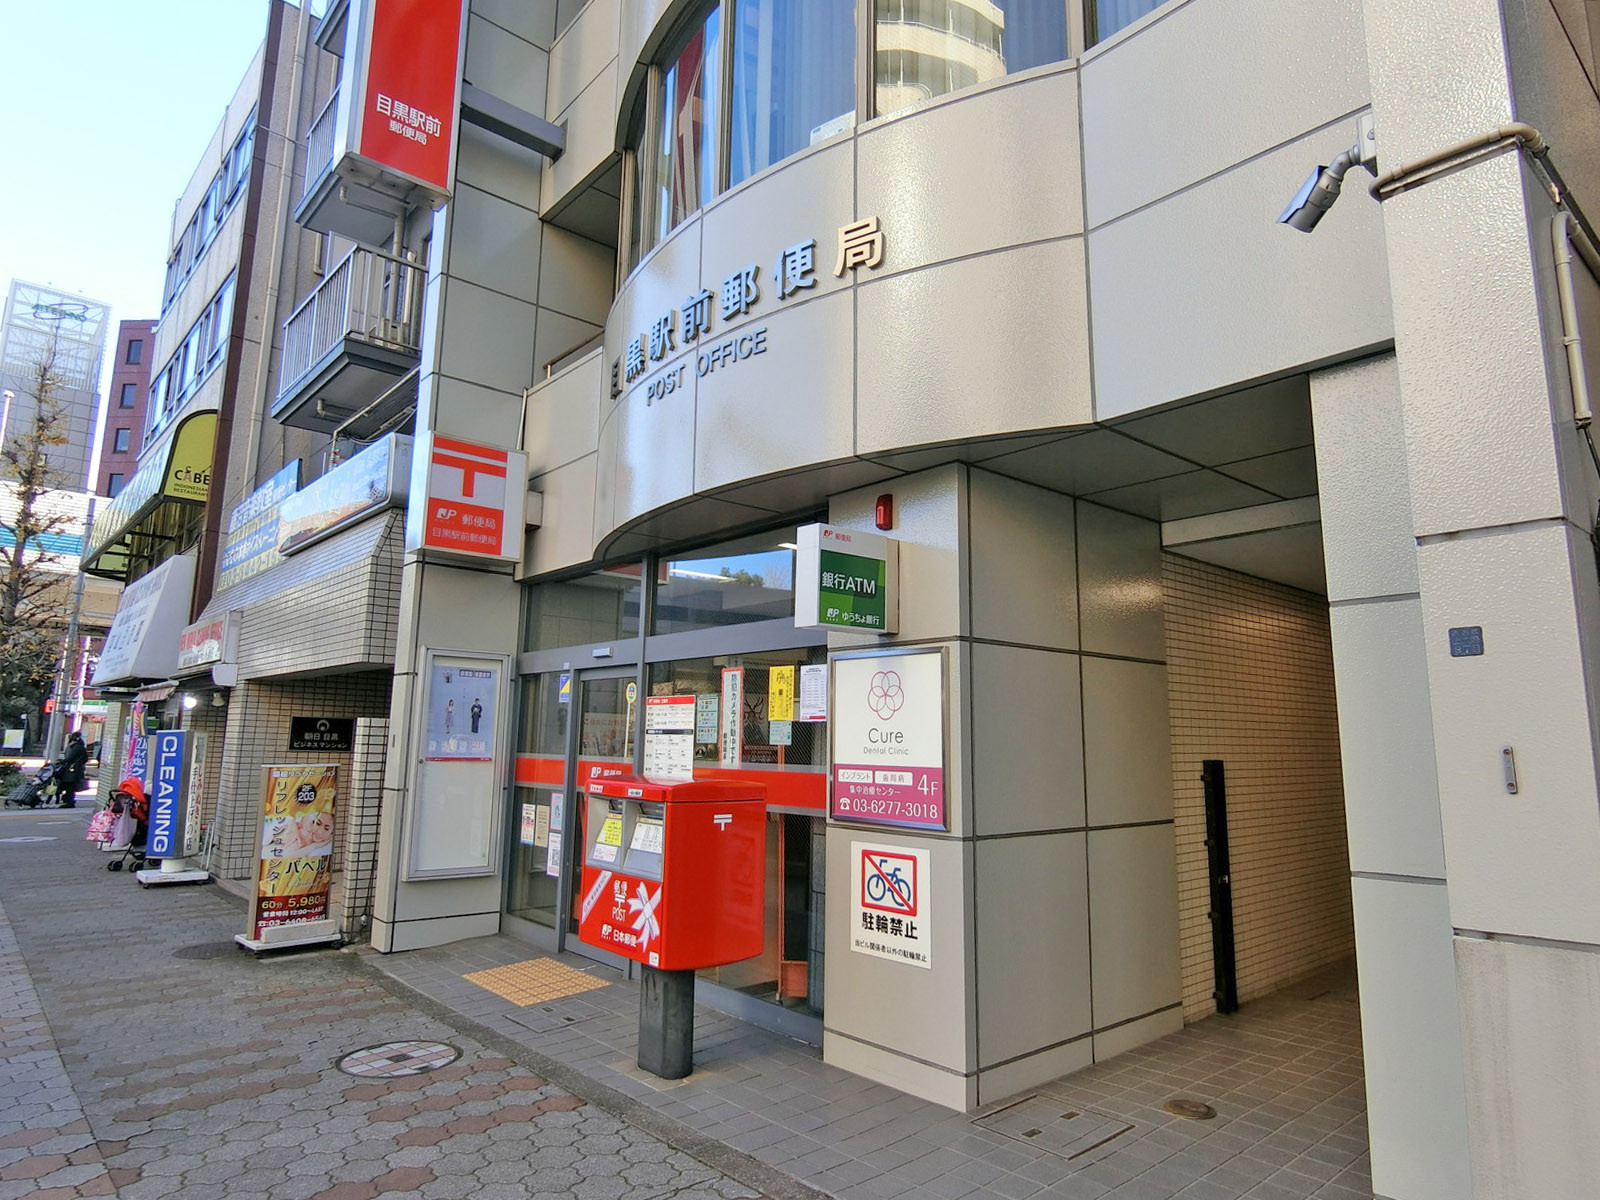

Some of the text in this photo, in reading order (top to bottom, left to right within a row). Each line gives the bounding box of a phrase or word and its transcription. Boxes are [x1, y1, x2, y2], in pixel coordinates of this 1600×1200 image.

[376, 93, 442, 137] 目黒駅前
[389, 119, 427, 145] 郵便局
[610, 215, 886, 401] 目黒駅前郵便局
[647, 327, 768, 407] POST OFFICE
[462, 514, 496, 530] 郵便局
[432, 527, 497, 546] 目黒駅前郵便局
[821, 571, 876, 595] 銀行ATM
[841, 612, 880, 625] ゆうちょ銀行
[868, 727, 904, 744] Cure
[863, 746, 909, 756] Dental Clinic
[840, 771, 871, 780] インプラント
[917, 773, 939, 797] 4F
[153, 735, 178, 853] CLEANING
[298, 791, 316, 801] 203
[849, 785, 901, 797] 集中治療センター
[853, 798, 938, 818] 03-6277-3018
[285, 859, 326, 874] バベル
[614, 879, 628, 897] 郵便
[612, 906, 627, 922] POST
[861, 911, 919, 940] 駐輪禁止
[613, 929, 637, 948] 日本郵便
[854, 938, 927, 963] 当ビル関係者以外の駐輪禁止
